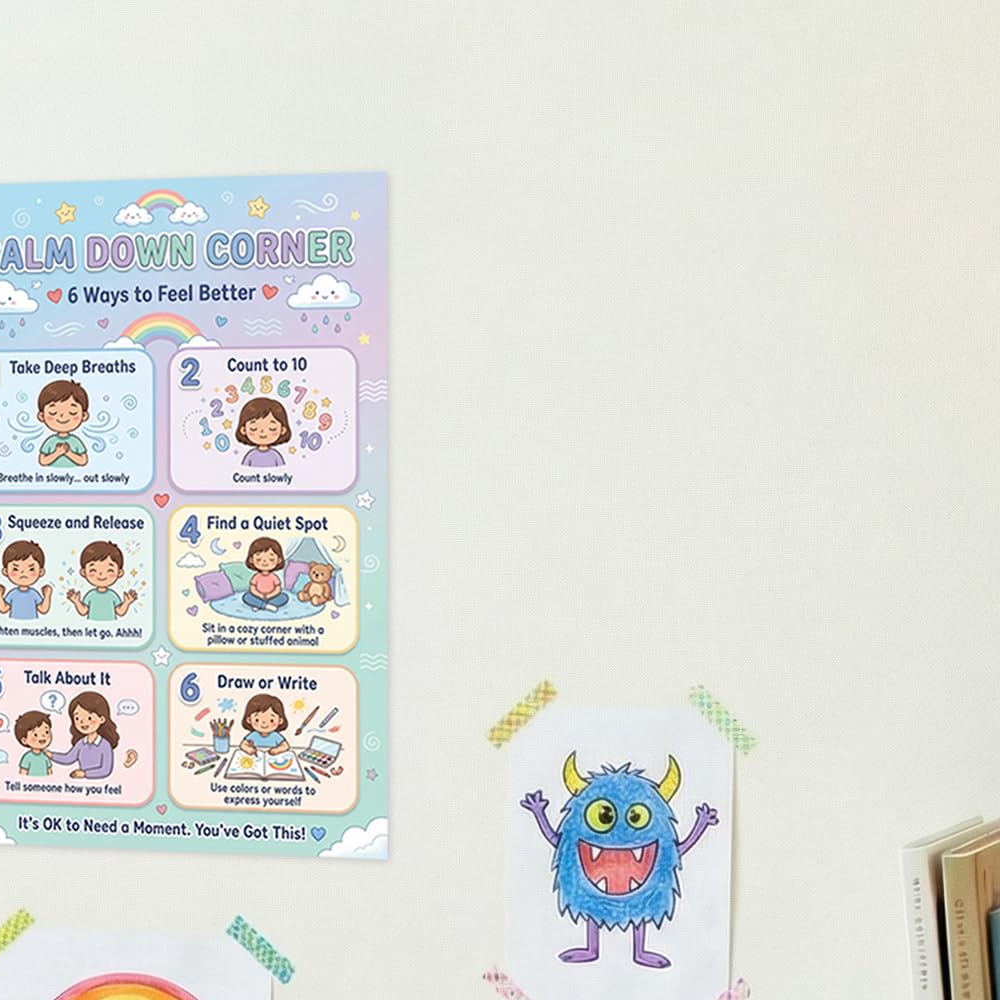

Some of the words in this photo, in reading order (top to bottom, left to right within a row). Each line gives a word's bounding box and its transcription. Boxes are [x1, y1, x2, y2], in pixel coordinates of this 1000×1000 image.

[86, 233, 194, 269] DOWN
[206, 230, 354, 267] CORNER
[68, 287, 78, 303] 6
[83, 287, 129, 307] Ways
[134, 286, 152, 302] to
[159, 284, 192, 302] Feel
[200, 284, 256, 301] Better
[10, 361, 40, 374] Take
[45, 360, 78, 376] Deep
[82, 360, 136, 373] Breaths
[180, 358, 200, 387] 2
[228, 358, 268, 372] Count
[273, 358, 288, 371] to
[292, 357, 307, 371] 10
[241, 377, 255, 394] 4
[260, 376, 273, 394] 5
[277, 380, 291, 397] 6
[225, 385, 239, 403] 3
[294, 386, 307, 404] 7
[210, 399, 224, 416] 2
[302, 401, 317, 419] 8
[199, 417, 212, 435] 1
[319, 413, 332, 431] 9
[215, 434, 230, 452] 0
[299, 431, 322, 450] 10
[35, 472, 44, 483] in
[83, 473, 99, 483] out
[101, 473, 129, 485] slowly
[233, 473, 260, 483] Count
[263, 473, 293, 485] slowly
[8, 515, 61, 531] Squeeze
[65, 515, 89, 529] and
[94, 515, 144, 529] Release
[179, 514, 201, 545] 4
[208, 516, 236, 529] Find
[241, 520, 249, 529] a
[253, 516, 291, 530] Quiet
[296, 516, 328, 533] Spot
[21, 627, 60, 637] muscles,
[62, 627, 83, 637] then
[84, 626, 98, 637] let
[100, 629, 114, 641] go.
[116, 628, 142, 637] Ahhh!
[202, 622, 216, 634] Sit
[217, 622, 227, 633] in
[236, 625, 259, 637] cozy
[261, 624, 292, 635] corner
[294, 623, 315, 635] with
[318, 627, 324, 635] a
[207, 634, 234, 646] pillow
[237, 636, 247, 646] or
[250, 634, 285, 647] stuffed
[286, 635, 320, 647] animal
[24, 670, 51, 684] Talk
[55, 671, 96, 685] About
[101, 672, 110, 685] It
[180, 673, 200, 702] 6
[217, 675, 255, 690] Draw
[259, 679, 274, 689] or
[278, 676, 317, 690] Write
[5, 781, 20, 791] Tell
[23, 784, 62, 792] someone
[65, 784, 83, 793] how
[86, 786, 102, 796] you
[105, 784, 121, 794] feel
[211, 783, 227, 792] Use
[230, 784, 259, 793] colors
[261, 786, 271, 794] or
[274, 785, 303, 795] words
[305, 786, 316, 795] to
[224, 796, 260, 805] express
[263, 797, 301, 807] yourself
[19, 817, 39, 830] It's
[43, 817, 61, 830] OK
[66, 819, 80, 831] to
[84, 819, 117, 832] Need
[121, 824, 129, 833] a
[134, 821, 190, 835] Moment.
[195, 823, 239, 837] You've
[244, 825, 268, 839] Got
[273, 826, 305, 840] This!
